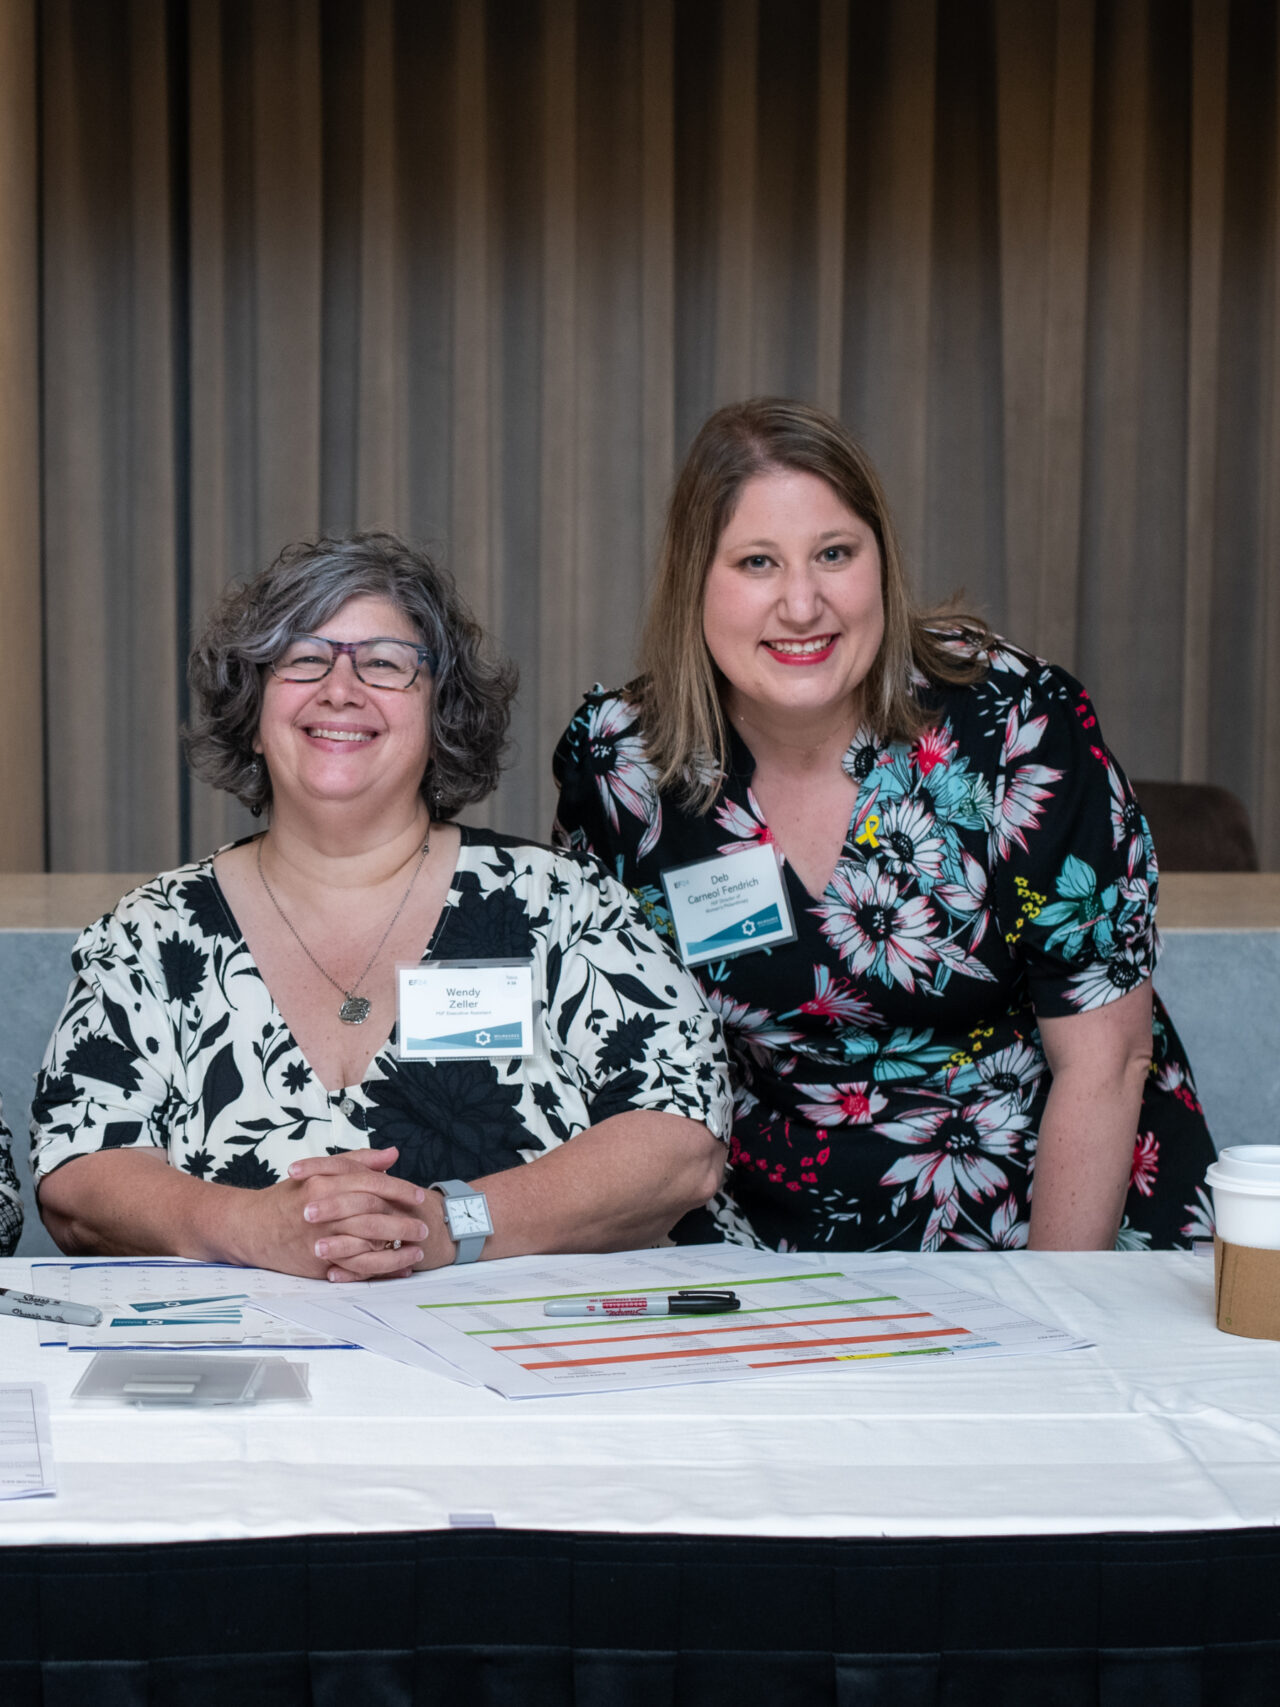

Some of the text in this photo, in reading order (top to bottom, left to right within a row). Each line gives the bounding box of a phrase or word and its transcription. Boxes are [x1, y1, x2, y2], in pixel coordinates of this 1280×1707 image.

[711, 873, 729, 885] Deb
[687, 878, 759, 905] Carneol Fendrich
[446, 988, 481, 999] Wendy
[449, 1000, 478, 1009] Zeller
